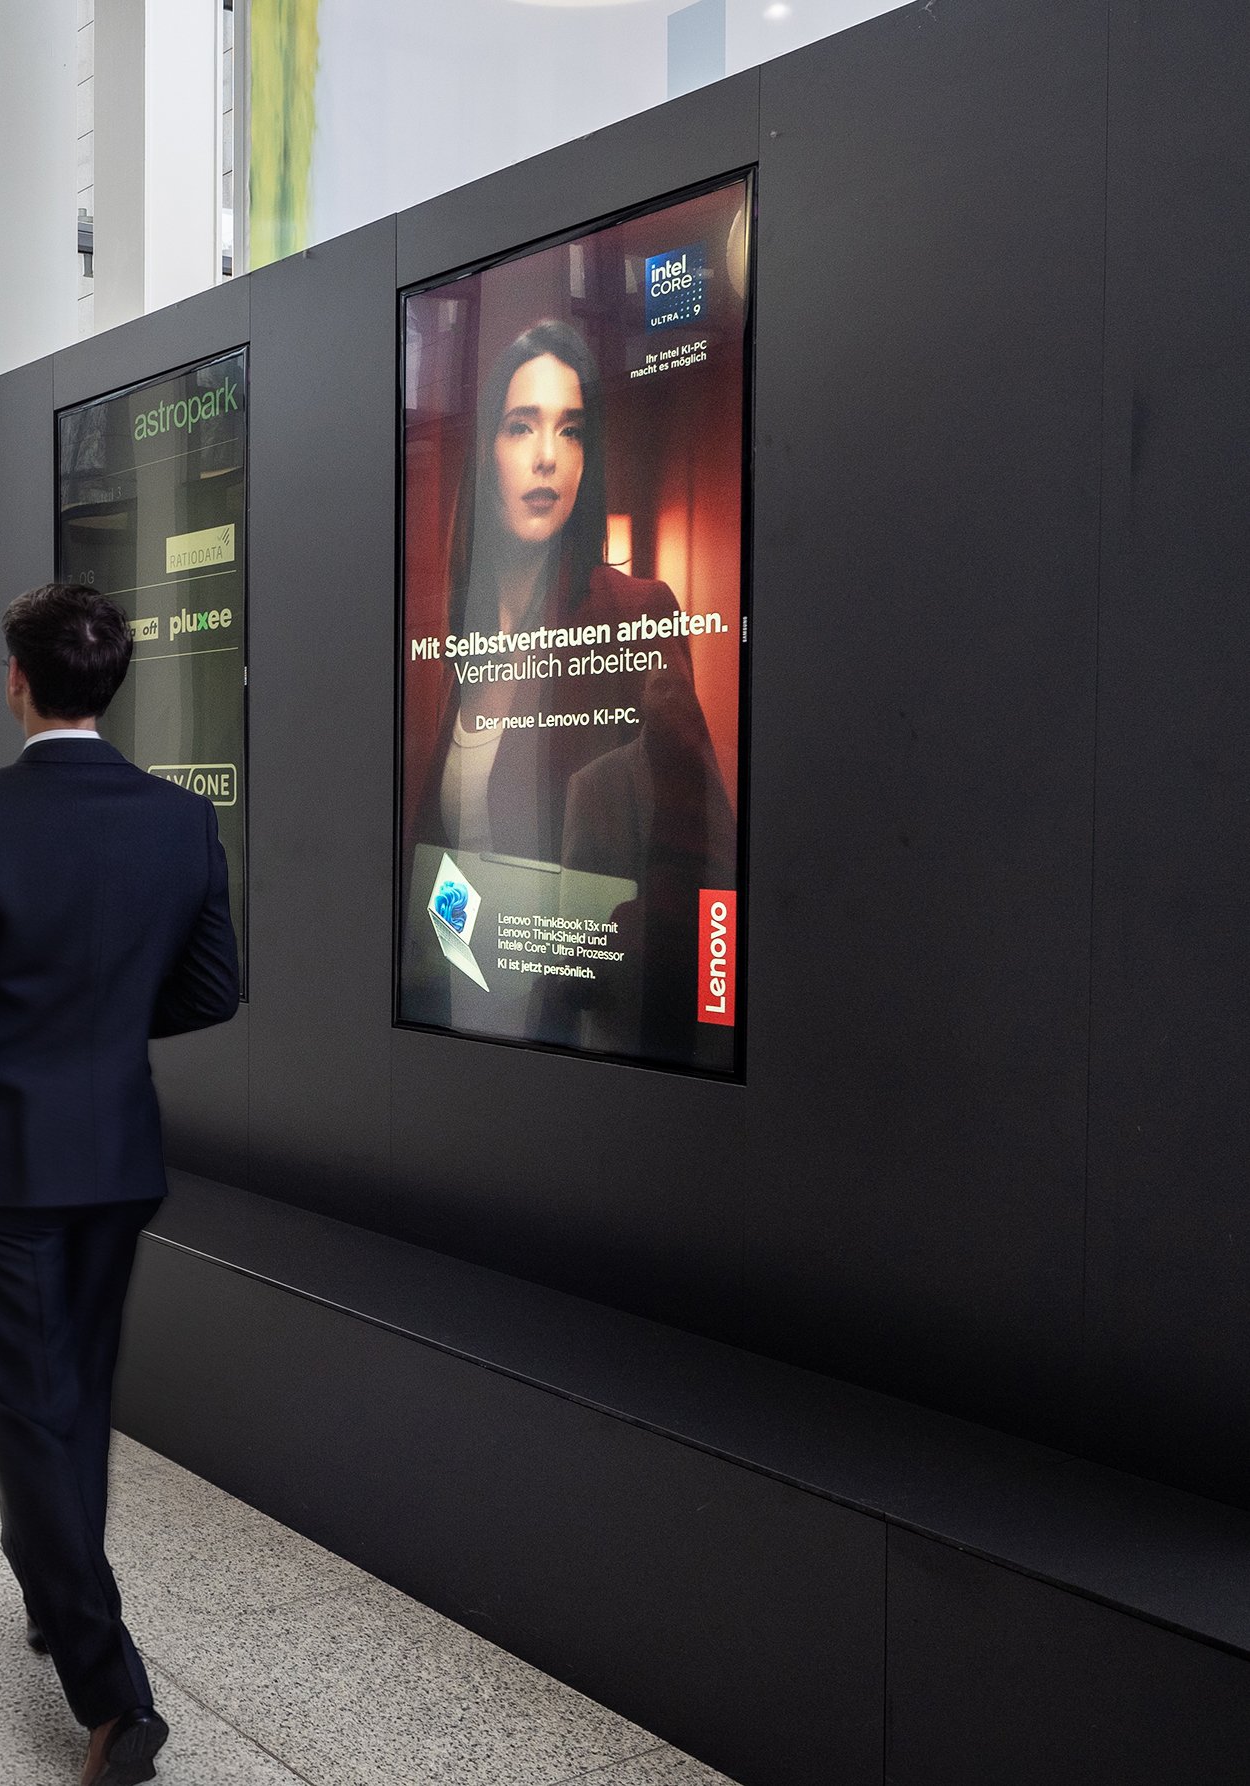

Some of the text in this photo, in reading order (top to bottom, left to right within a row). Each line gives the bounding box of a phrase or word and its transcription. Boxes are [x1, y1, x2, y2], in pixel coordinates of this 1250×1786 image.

[651, 254, 686, 283] intel
[651, 304, 701, 326] ULTRA 9
[646, 340, 707, 364] Ihr Intel KI-PC
[630, 351, 707, 379] macht es möglich
[134, 376, 238, 441] astropark
[170, 546, 223, 568] RATIODATA
[170, 608, 233, 641] pluxee
[411, 611, 729, 661] Mit Selbstvertrauen arbeiten.
[454, 648, 668, 685] Vertraulich arbeiten.
[475, 707, 640, 731] Der neue Lenovo KI-PC.
[497, 913, 619, 934] Lenovo ThinkBook 13x mit
[497, 926, 607, 946] Lenovo ThinkShield und
[551, 943, 575, 957] Ultra
[576, 946, 625, 962] Prozessor
[705, 901, 727, 1013] Lenovo
[497, 958, 596, 979] KI ist jetzt persönlich.
